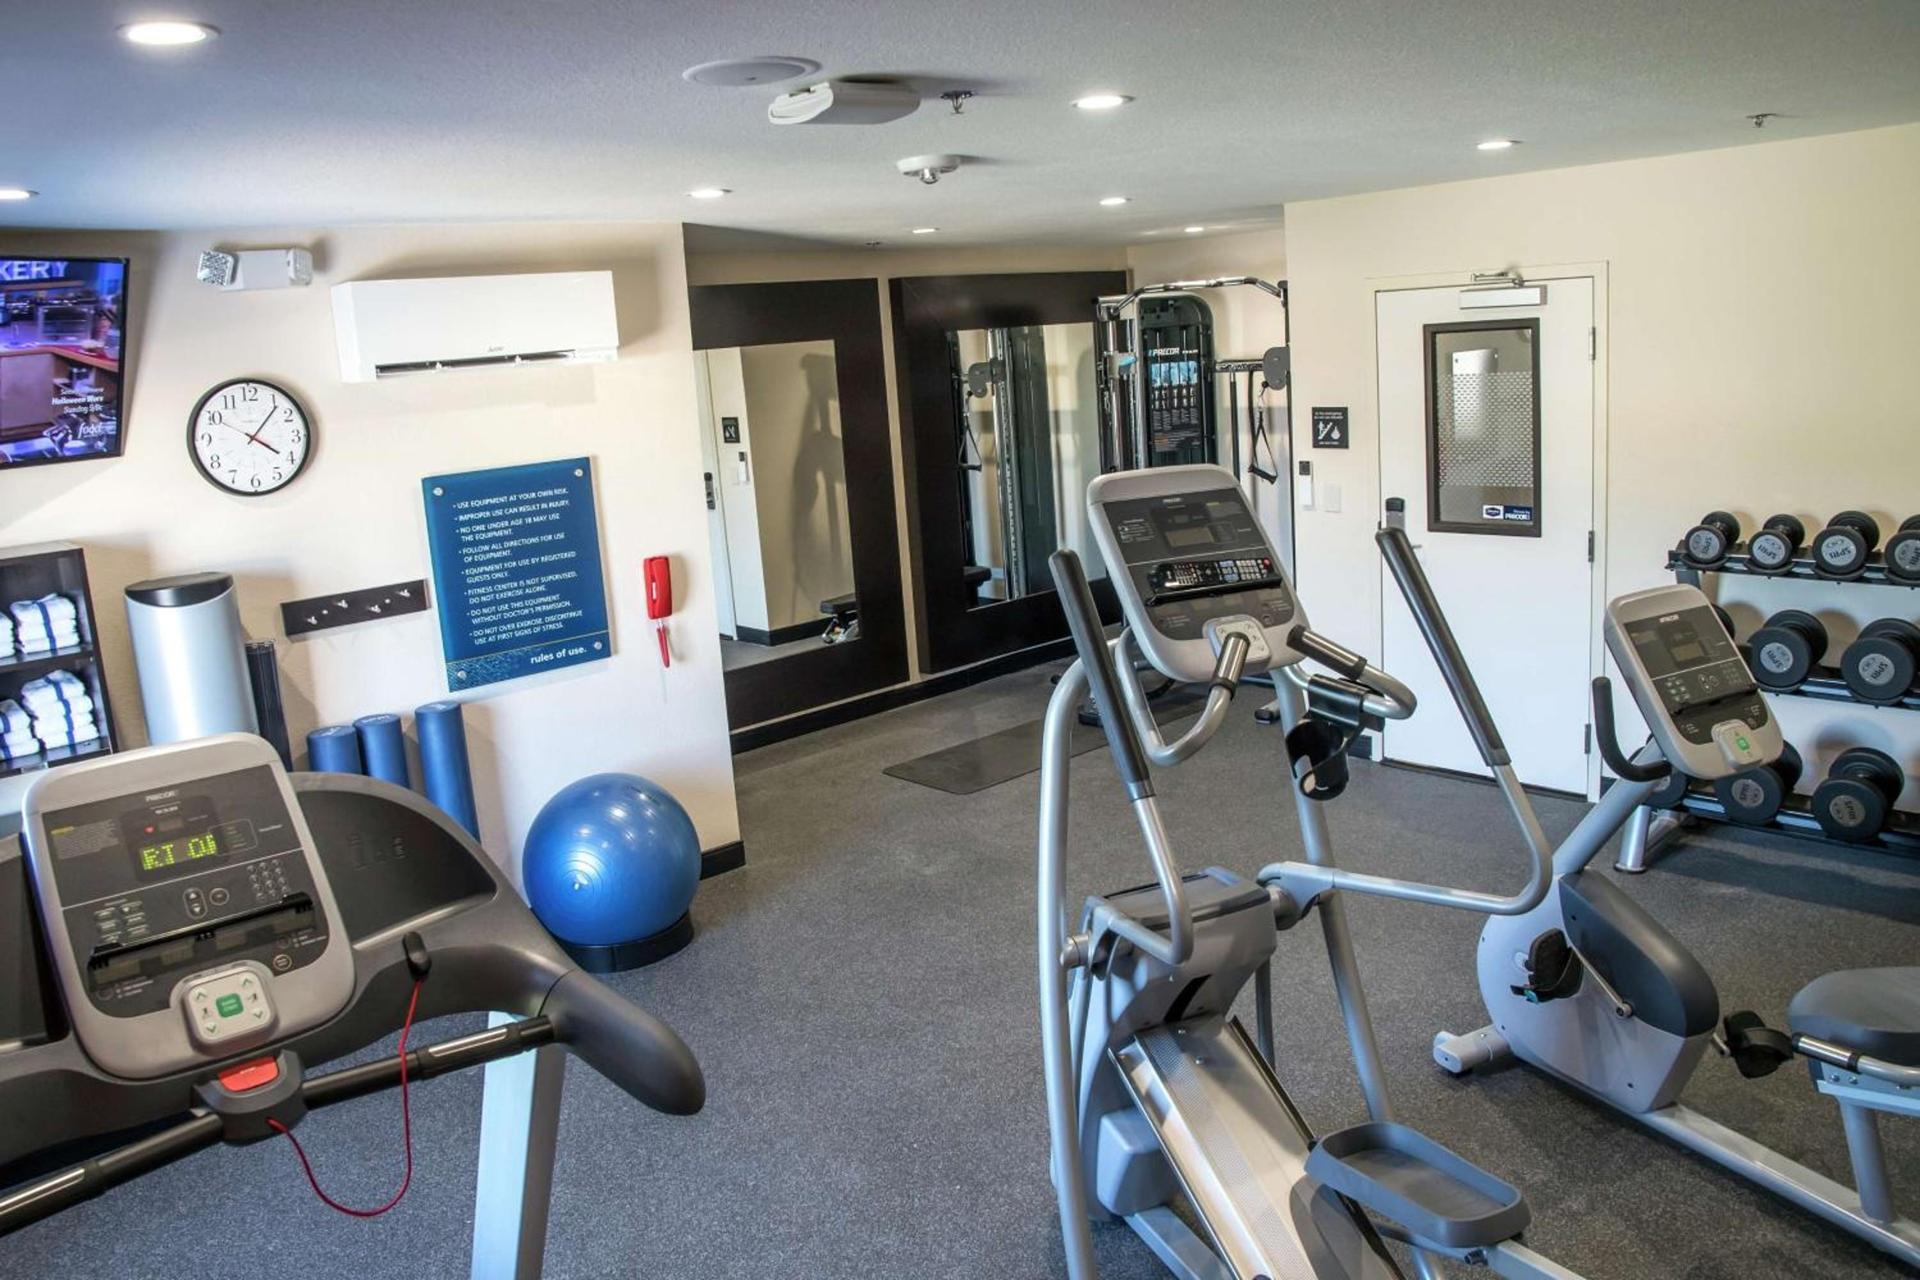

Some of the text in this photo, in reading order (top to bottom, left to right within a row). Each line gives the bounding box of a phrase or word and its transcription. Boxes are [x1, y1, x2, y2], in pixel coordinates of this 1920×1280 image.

[242, 386, 259, 402] 12
[271, 393, 278, 408] 1
[223, 394, 236, 410] 11
[206, 410, 223, 426] 10
[283, 407, 293, 422] 2
[201, 433, 212, 447] 9
[291, 429, 301, 443] 3
[210, 454, 221, 469] 8
[287, 450, 296, 465] 4
[228, 469, 237, 485] 7
[250, 473, 261, 488] 6
[272, 466, 282, 481] 5
[470, 496, 508, 507] EQUIPMENT
[518, 492, 536, 500] YOUR
[487, 521, 509, 530] UNDER
[533, 515, 547, 523] MAY
[463, 545, 490, 555] FOLLOW
[466, 564, 503, 575] EQUIPMENT
[481, 594, 495, 602] NOT
[471, 609, 481, 617] DO
[482, 606, 497, 614] NOT
[472, 614, 502, 625] WITHOUT
[485, 627, 498, 635] NOT
[499, 623, 515, 632] OVER
[488, 635, 496, 643] AT
[530, 647, 587, 664] rules of use.
